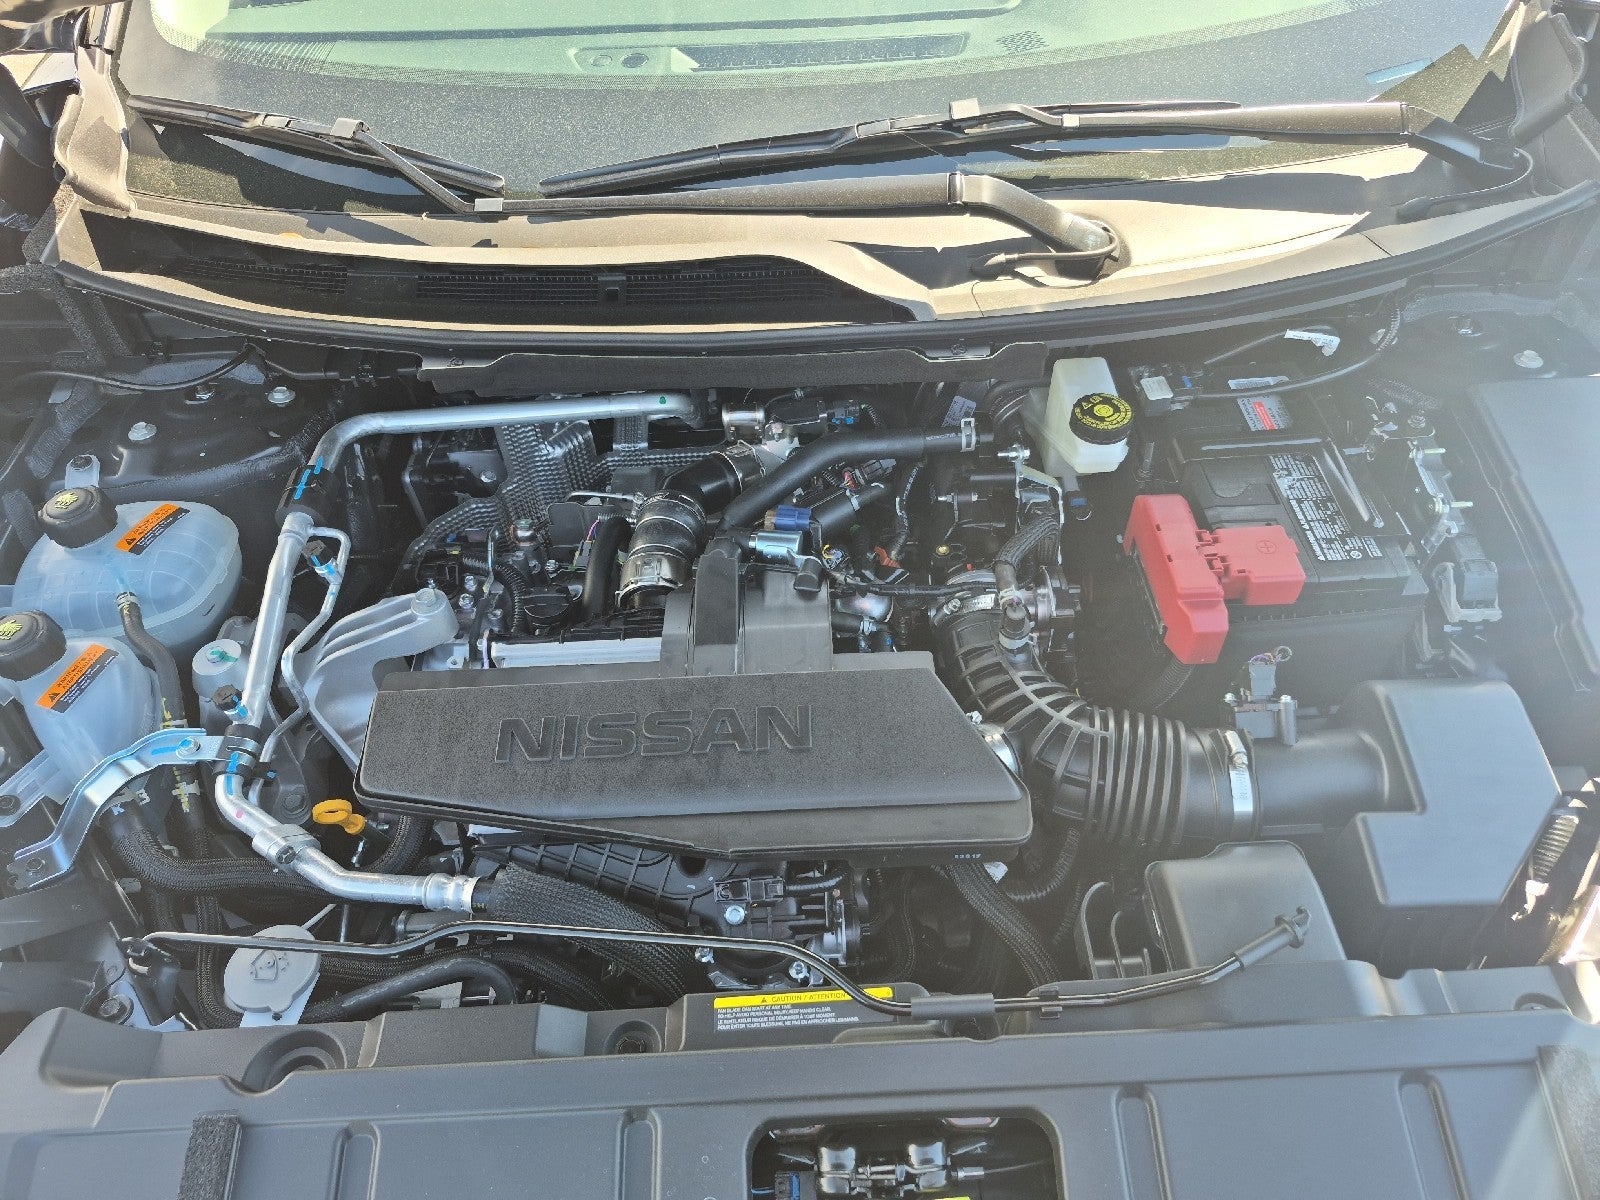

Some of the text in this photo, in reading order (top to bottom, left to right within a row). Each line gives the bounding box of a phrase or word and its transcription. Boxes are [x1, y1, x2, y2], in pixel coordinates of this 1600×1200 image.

[494, 704, 813, 763] NISSAN
[771, 995, 802, 1003] CAUTION
[809, 992, 846, 1000] ATTENTION
